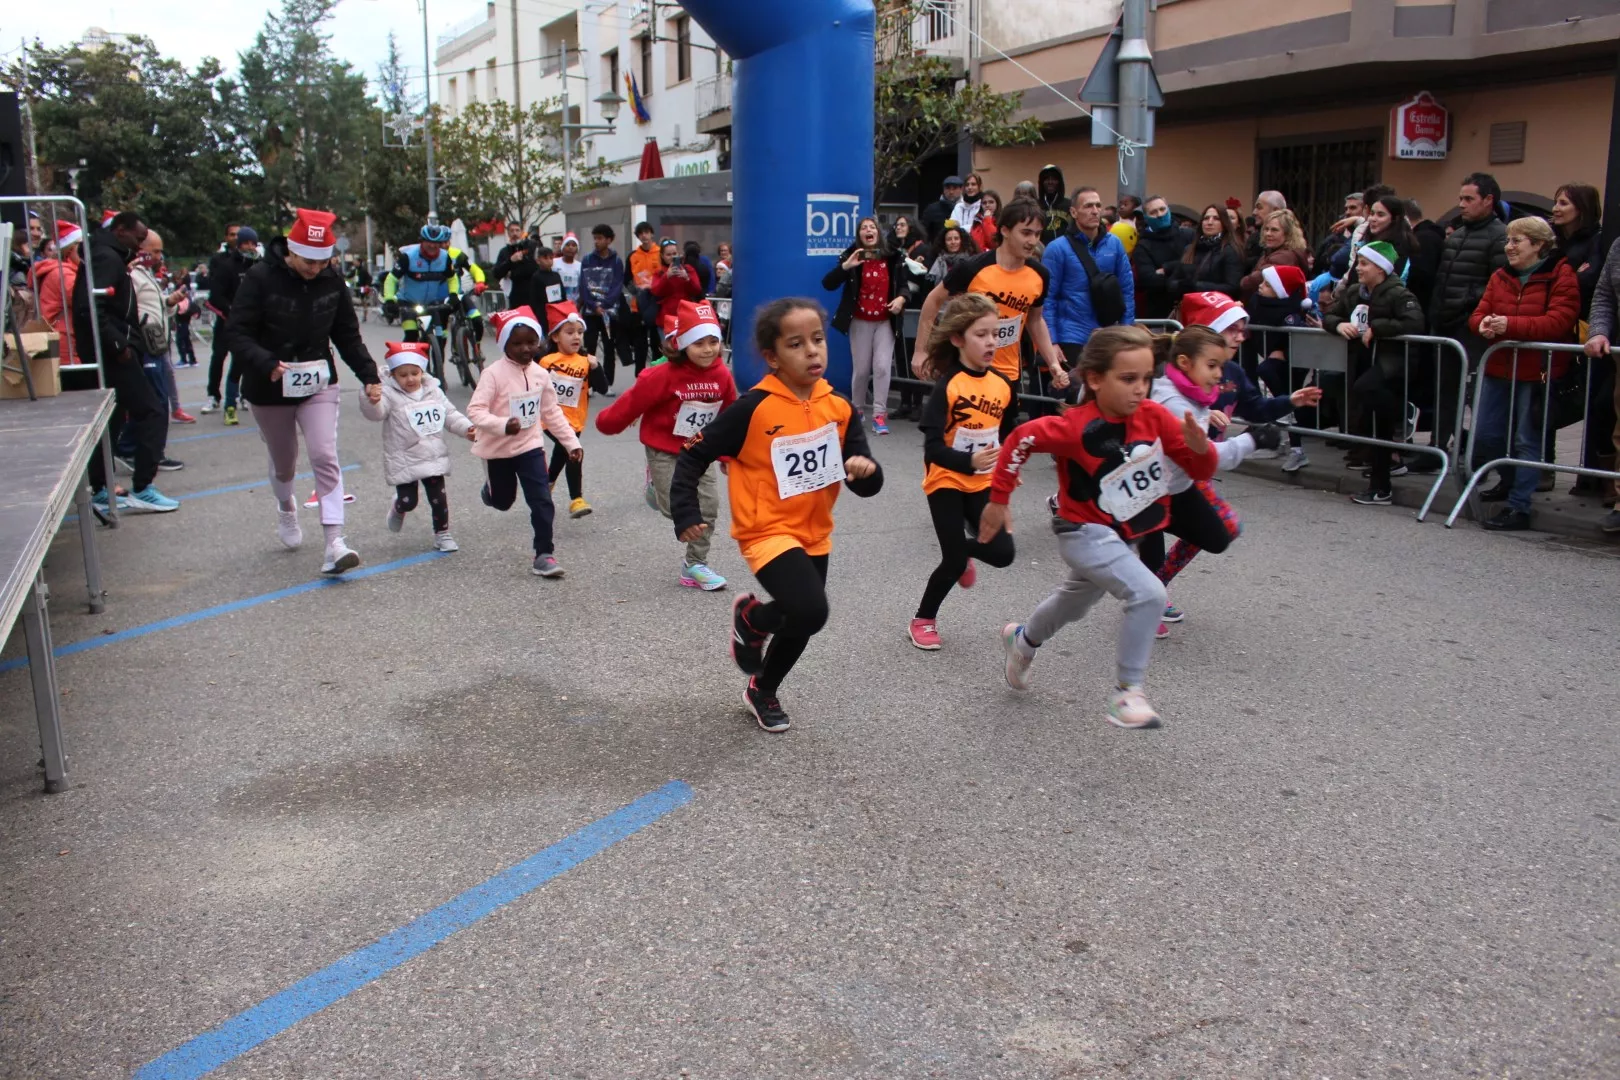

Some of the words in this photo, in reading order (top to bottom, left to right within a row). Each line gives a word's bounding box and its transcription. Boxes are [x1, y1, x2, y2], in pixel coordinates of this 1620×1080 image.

[1410, 111, 1441, 124] Estrella
[1400, 149, 1413, 157] BAR
[806, 203, 860, 237] bnf
[291, 370, 320, 387] 221
[686, 382, 713, 391] MERRY
[414, 408, 441, 426] 216
[963, 422, 985, 430] club
[784, 443, 829, 478] 287
[1118, 461, 1162, 498] 186
